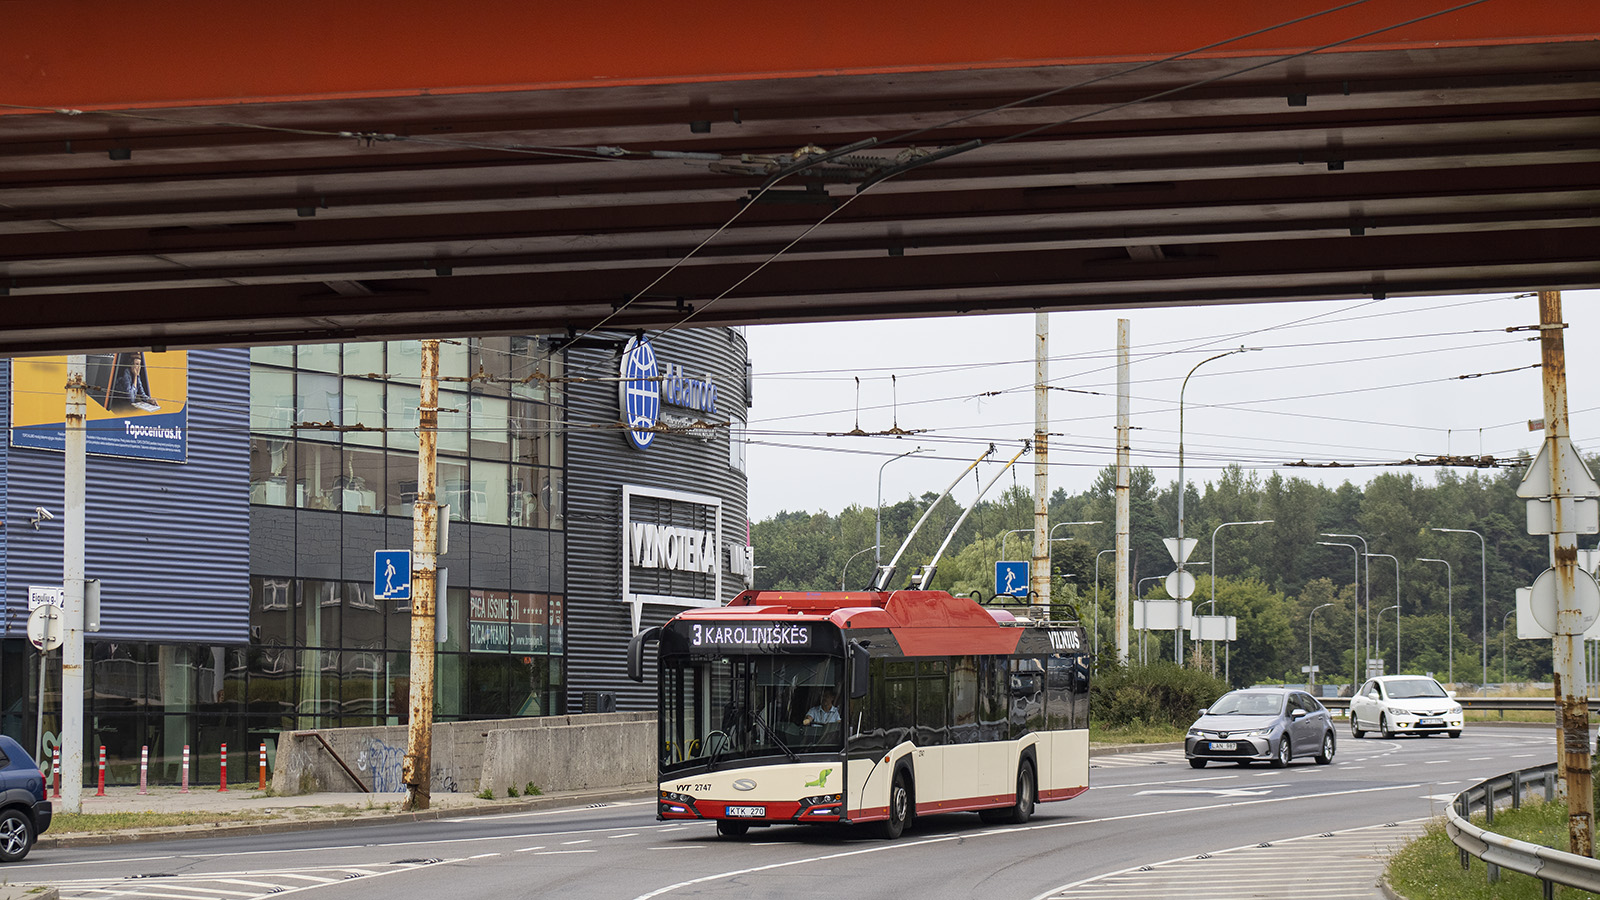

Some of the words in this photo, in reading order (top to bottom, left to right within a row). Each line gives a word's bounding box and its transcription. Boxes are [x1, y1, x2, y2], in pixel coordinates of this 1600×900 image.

[661, 363, 718, 414] delamode
[693, 624, 702, 646] 3
[705, 624, 808, 645] KAROLINIŠKĖS
[1047, 630, 1080, 649] VILNIUS
[694, 783, 712, 792] 2747
[730, 807, 746, 815] KTK
[750, 807, 764, 815] 270
